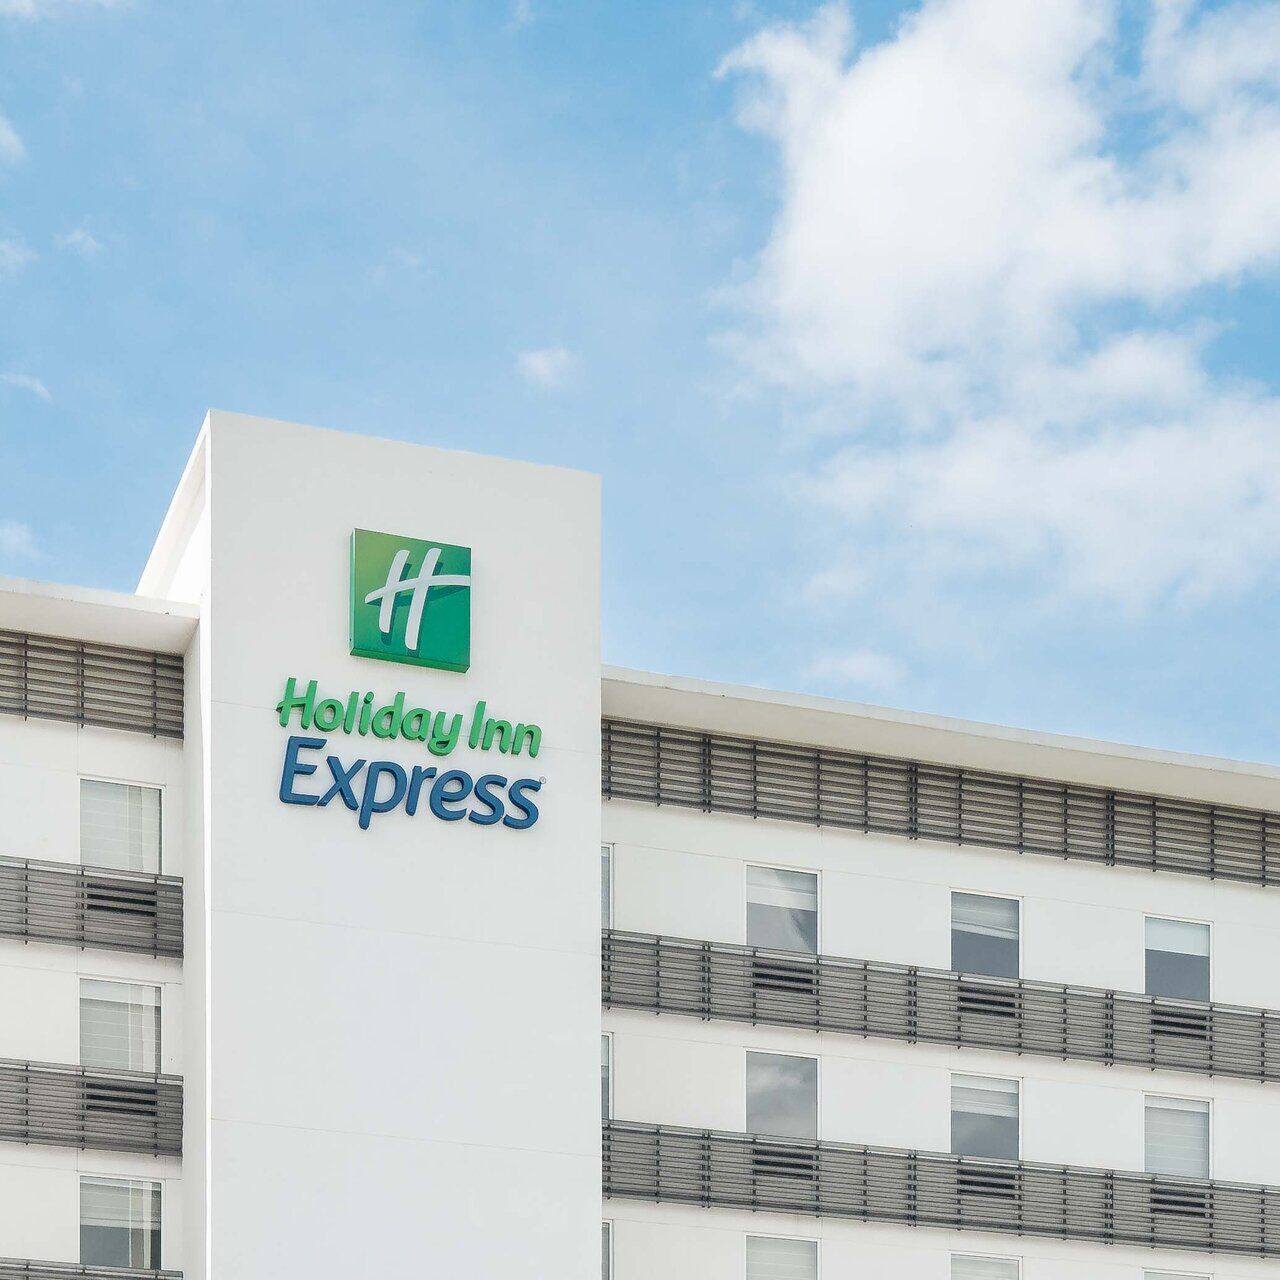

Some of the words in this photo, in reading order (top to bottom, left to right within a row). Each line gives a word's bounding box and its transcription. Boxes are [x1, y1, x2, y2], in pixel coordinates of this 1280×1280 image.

[275, 677, 463, 757] Holiday
[468, 701, 542, 758] Inn
[279, 735, 541, 830] Express
